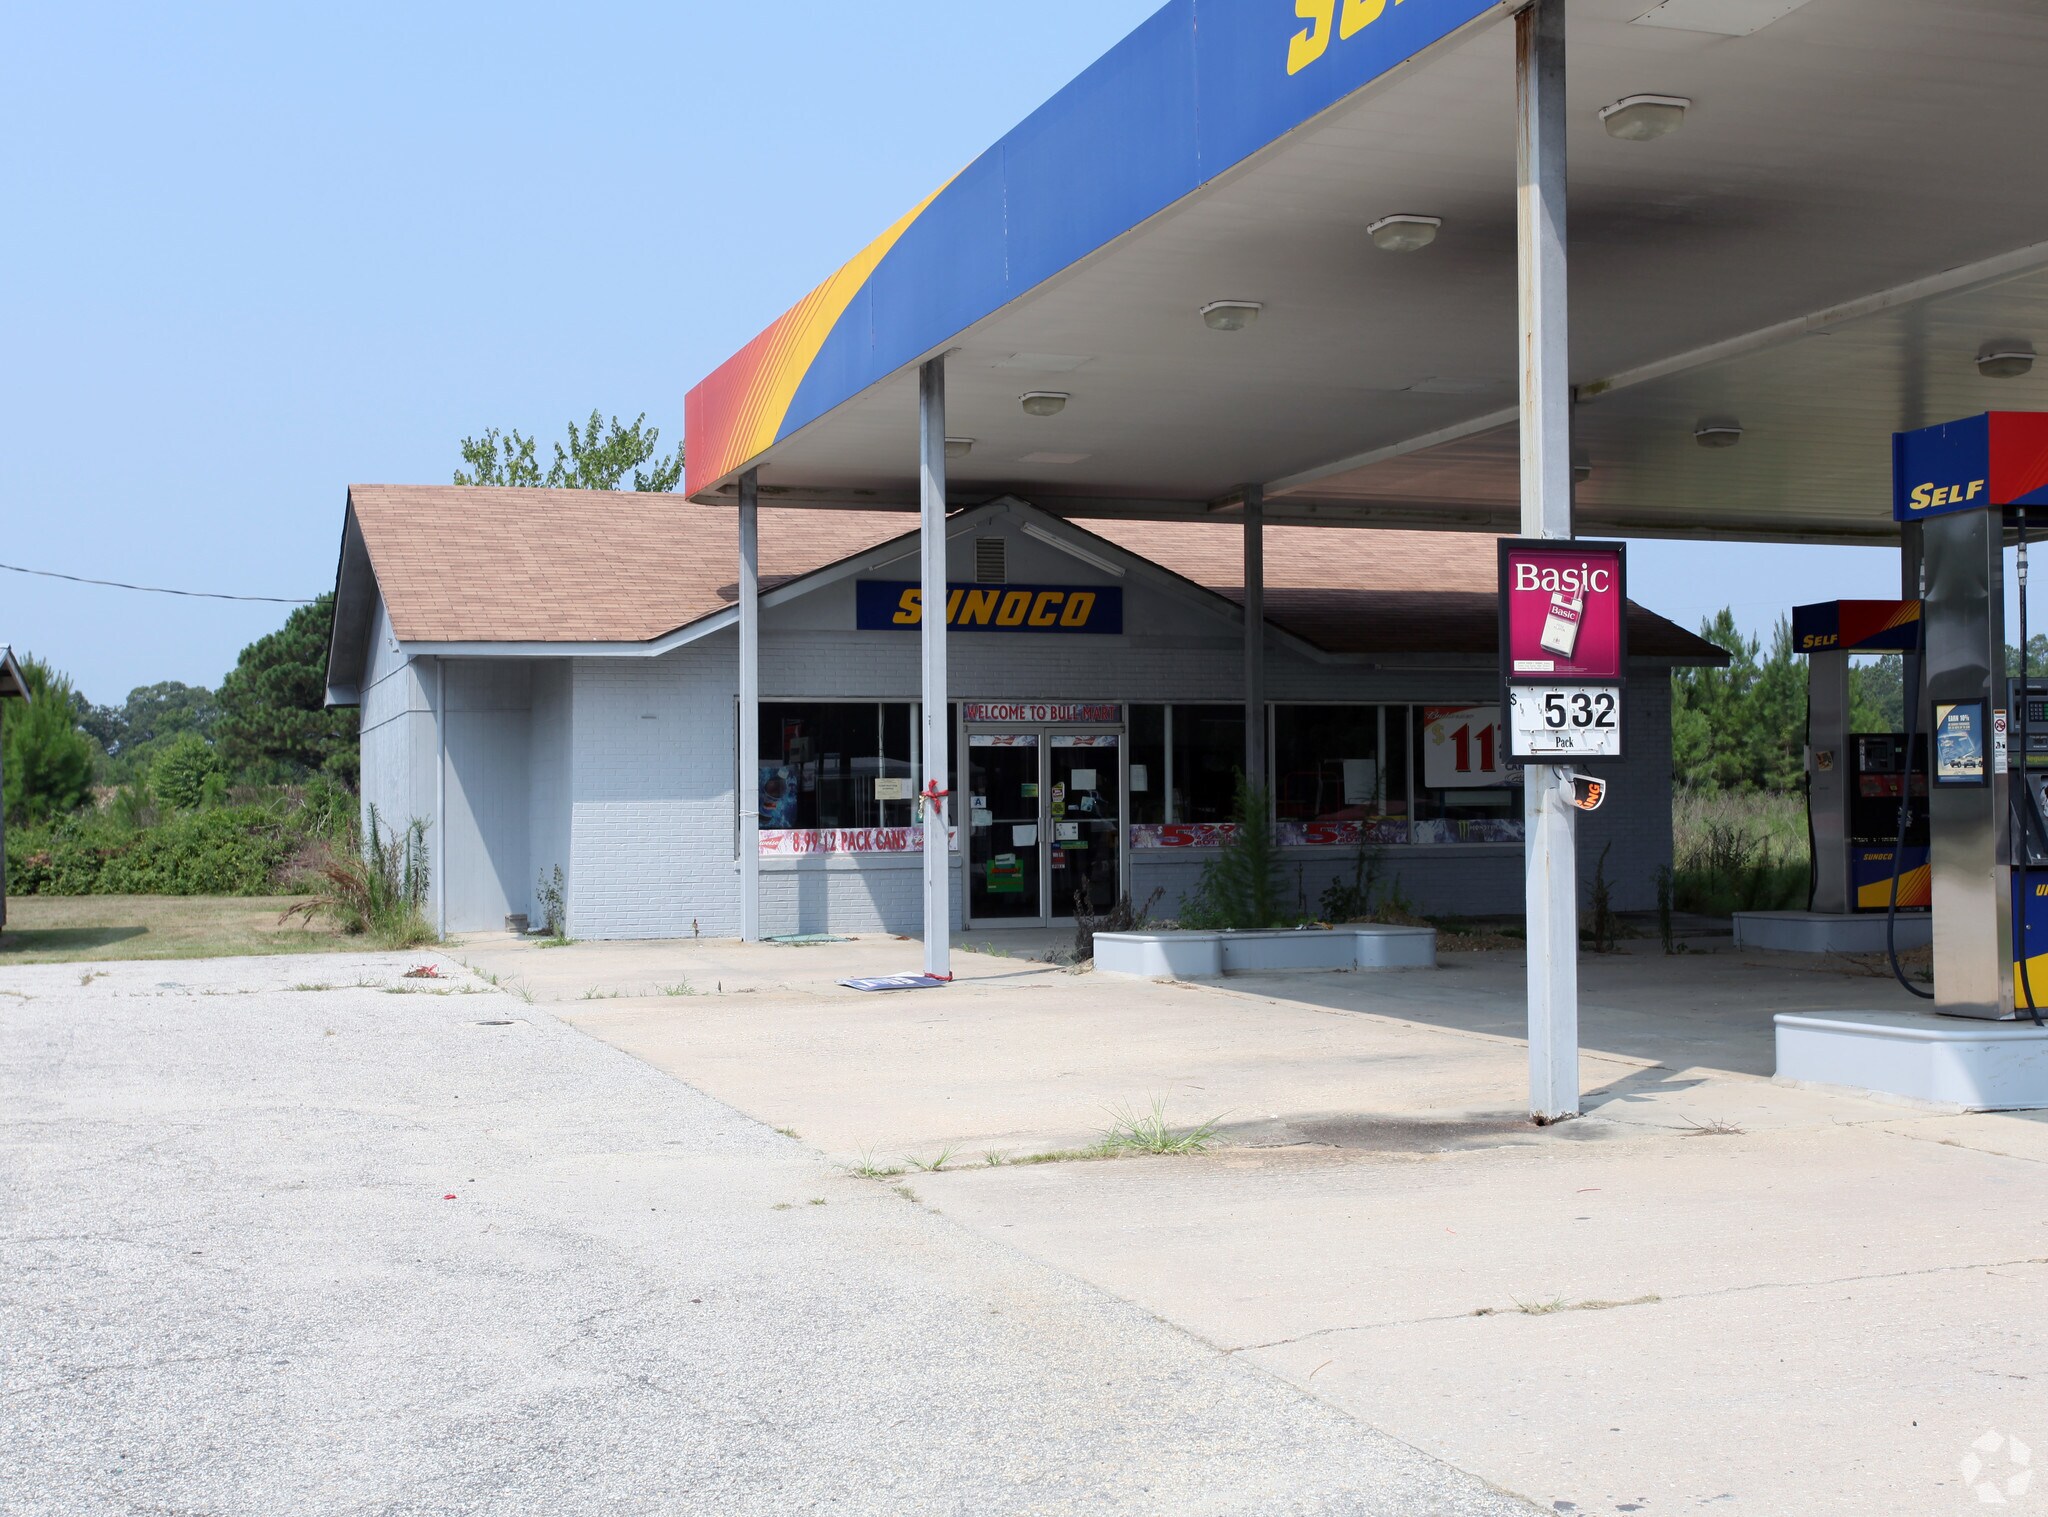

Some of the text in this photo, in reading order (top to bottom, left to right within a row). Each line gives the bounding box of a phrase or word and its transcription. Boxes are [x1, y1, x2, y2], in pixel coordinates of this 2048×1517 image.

[1909, 479, 1984, 510] SELF
[1515, 562, 1609, 593] Basic
[1551, 605, 1576, 620] Basic
[1802, 633, 1838, 649] SELF
[967, 704, 1114, 720] WELCOME TO BULL MART
[1545, 693, 1615, 728] 532
[1555, 736, 1574, 748] Pack
[975, 798, 982, 806] A
[793, 831, 819, 852] 8.99
[823, 831, 837, 851] 12
[841, 830, 872, 851] PACK
[876, 828, 907, 850] CANS
[1863, 853, 1893, 861] SUNOCO
